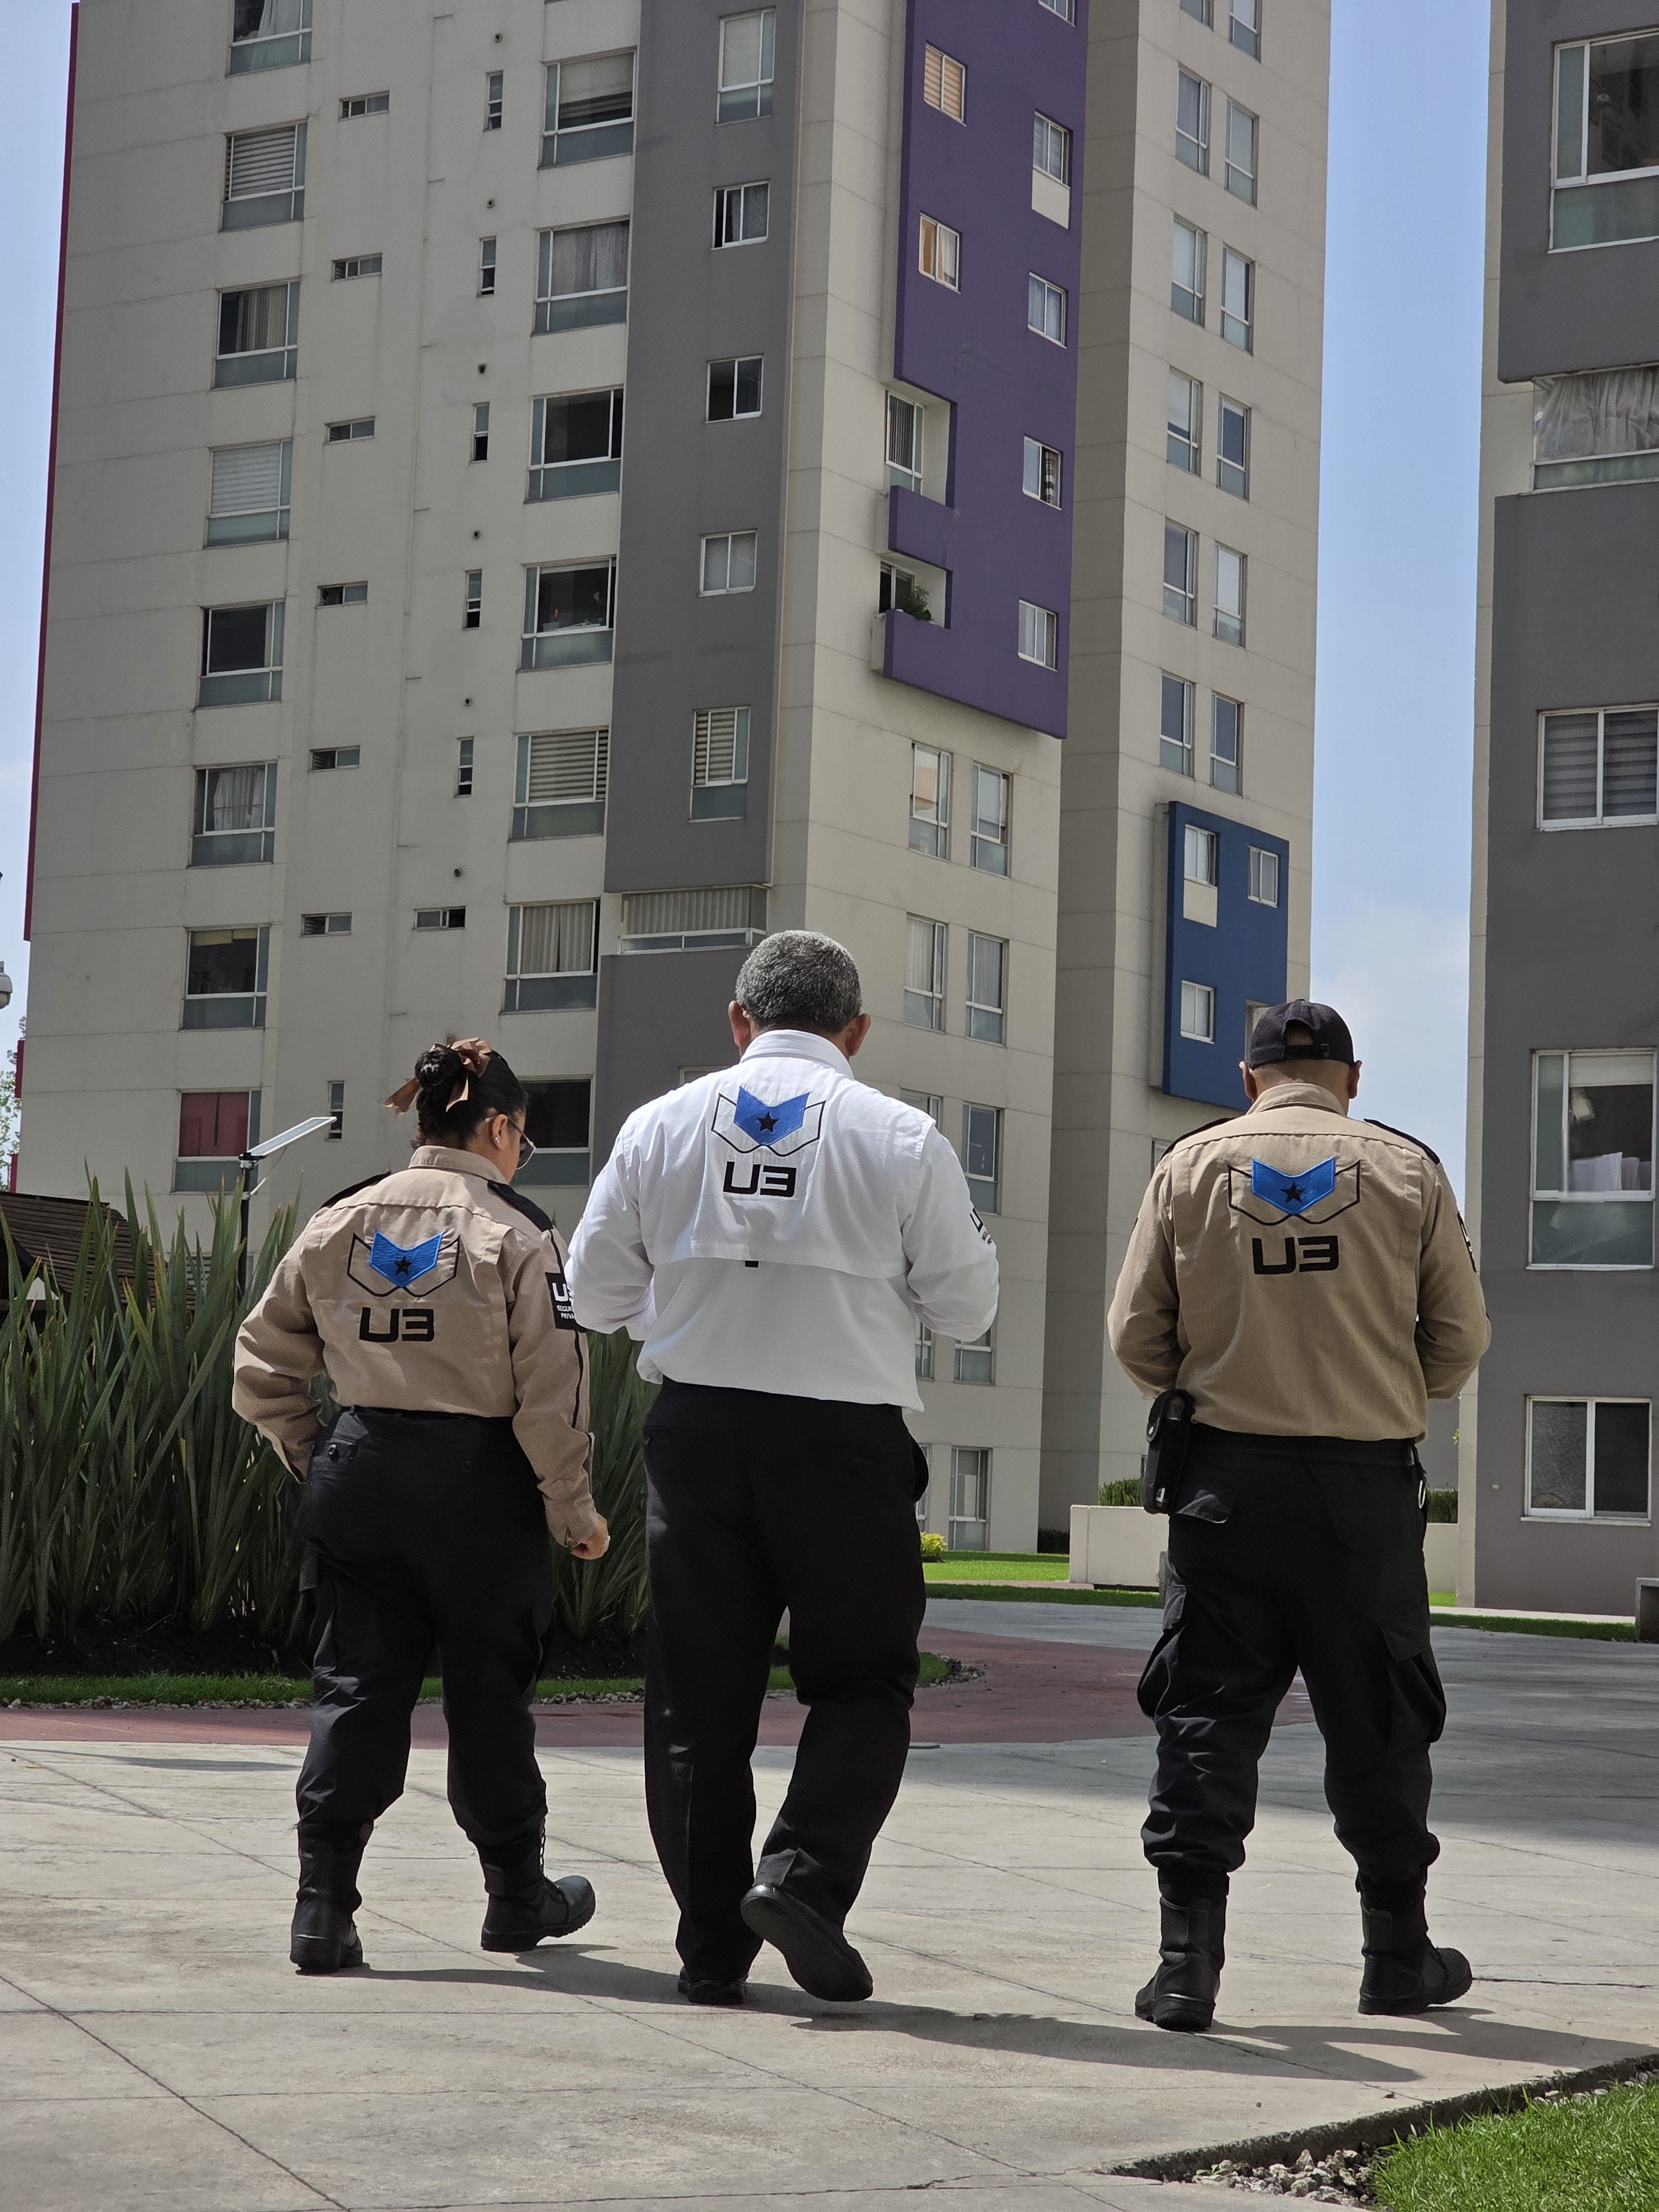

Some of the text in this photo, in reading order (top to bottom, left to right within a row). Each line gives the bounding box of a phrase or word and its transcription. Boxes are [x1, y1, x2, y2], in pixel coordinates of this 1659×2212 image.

[723, 1161, 796, 1198] U3
[1252, 1235, 1339, 1275] U3
[359, 1307, 435, 1343] U3
